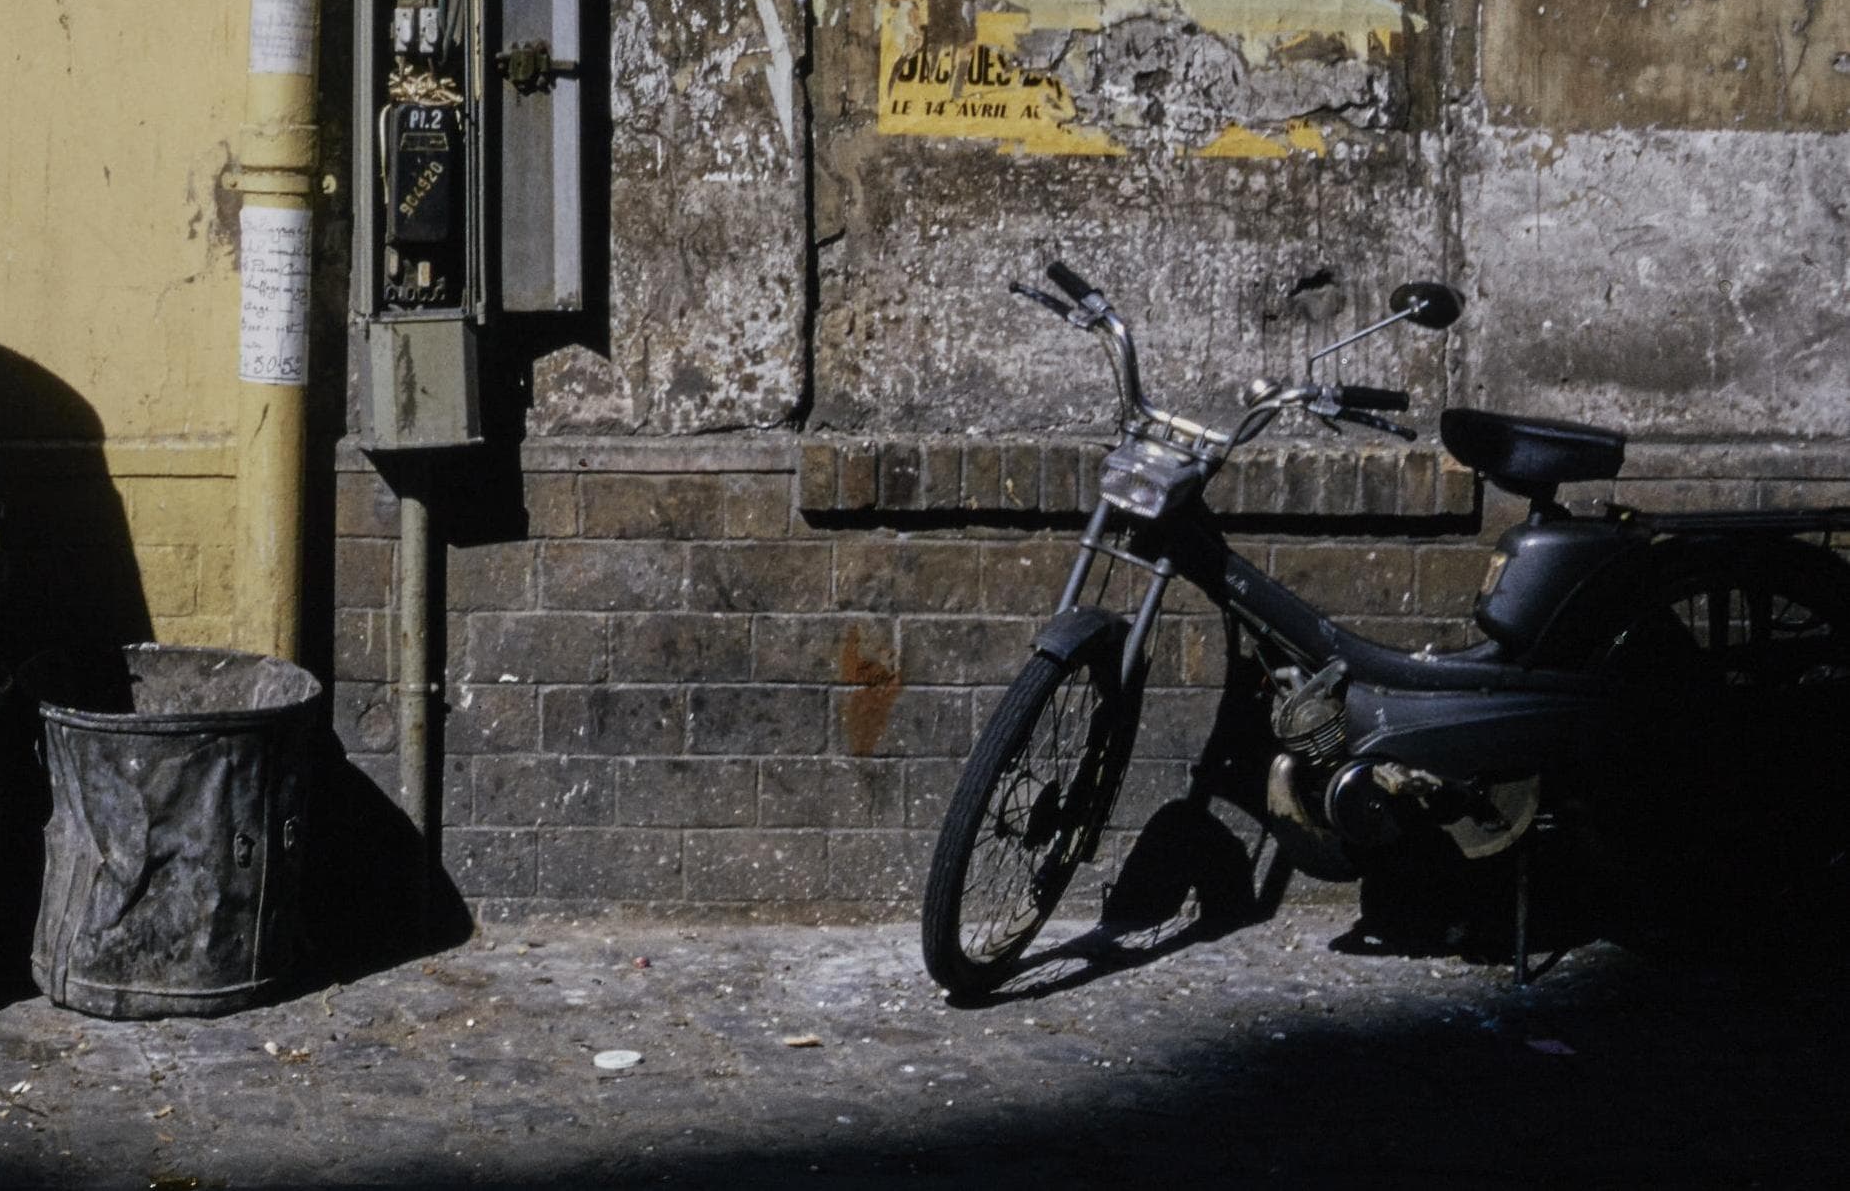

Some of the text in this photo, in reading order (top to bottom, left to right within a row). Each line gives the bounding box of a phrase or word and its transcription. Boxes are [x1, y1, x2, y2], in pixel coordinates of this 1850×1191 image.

[891, 100, 912, 115] LE
[925, 100, 946, 116] 14
[956, 101, 1007, 119] AVRIL
